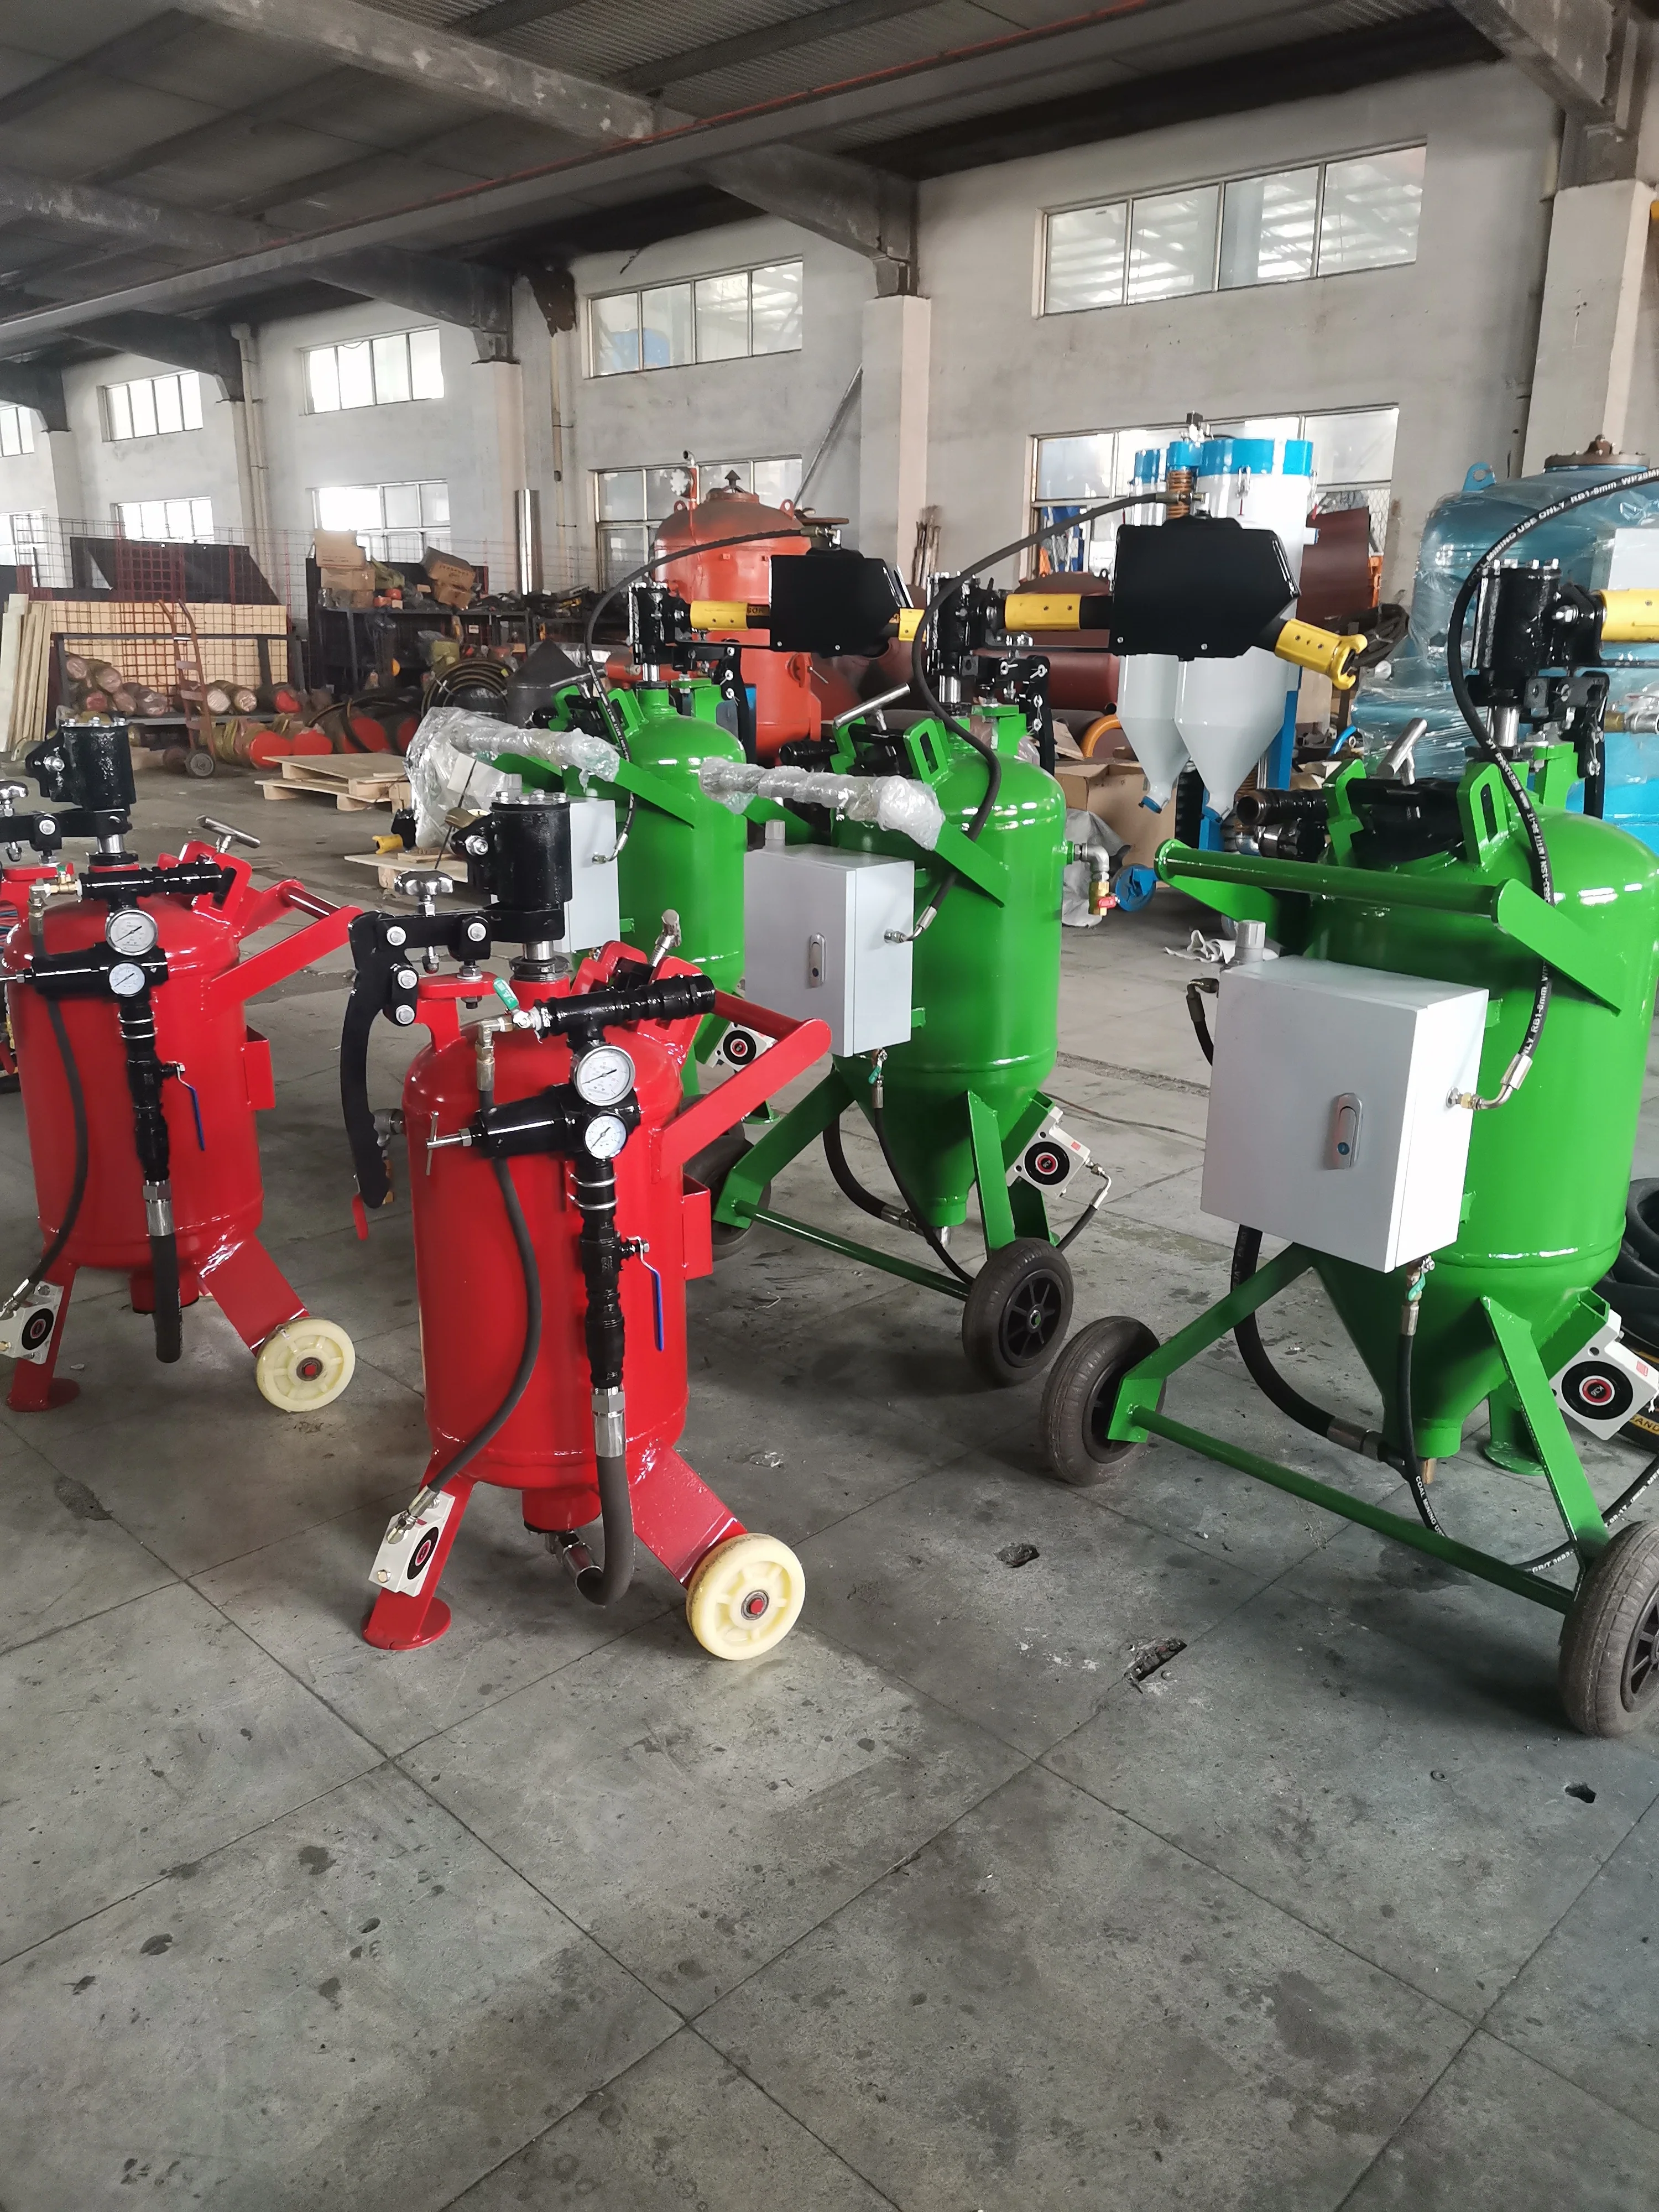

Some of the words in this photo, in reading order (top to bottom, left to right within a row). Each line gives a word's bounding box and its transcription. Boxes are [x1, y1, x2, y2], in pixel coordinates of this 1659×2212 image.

[1538, 501, 1565, 520] ONLY
[1530, 986, 1547, 1033] RB1-8mm
[1590, 1385, 1605, 1397] K36
[1416, 1475, 1426, 1499] COAL
[1423, 1498, 1437, 1525] MINING
